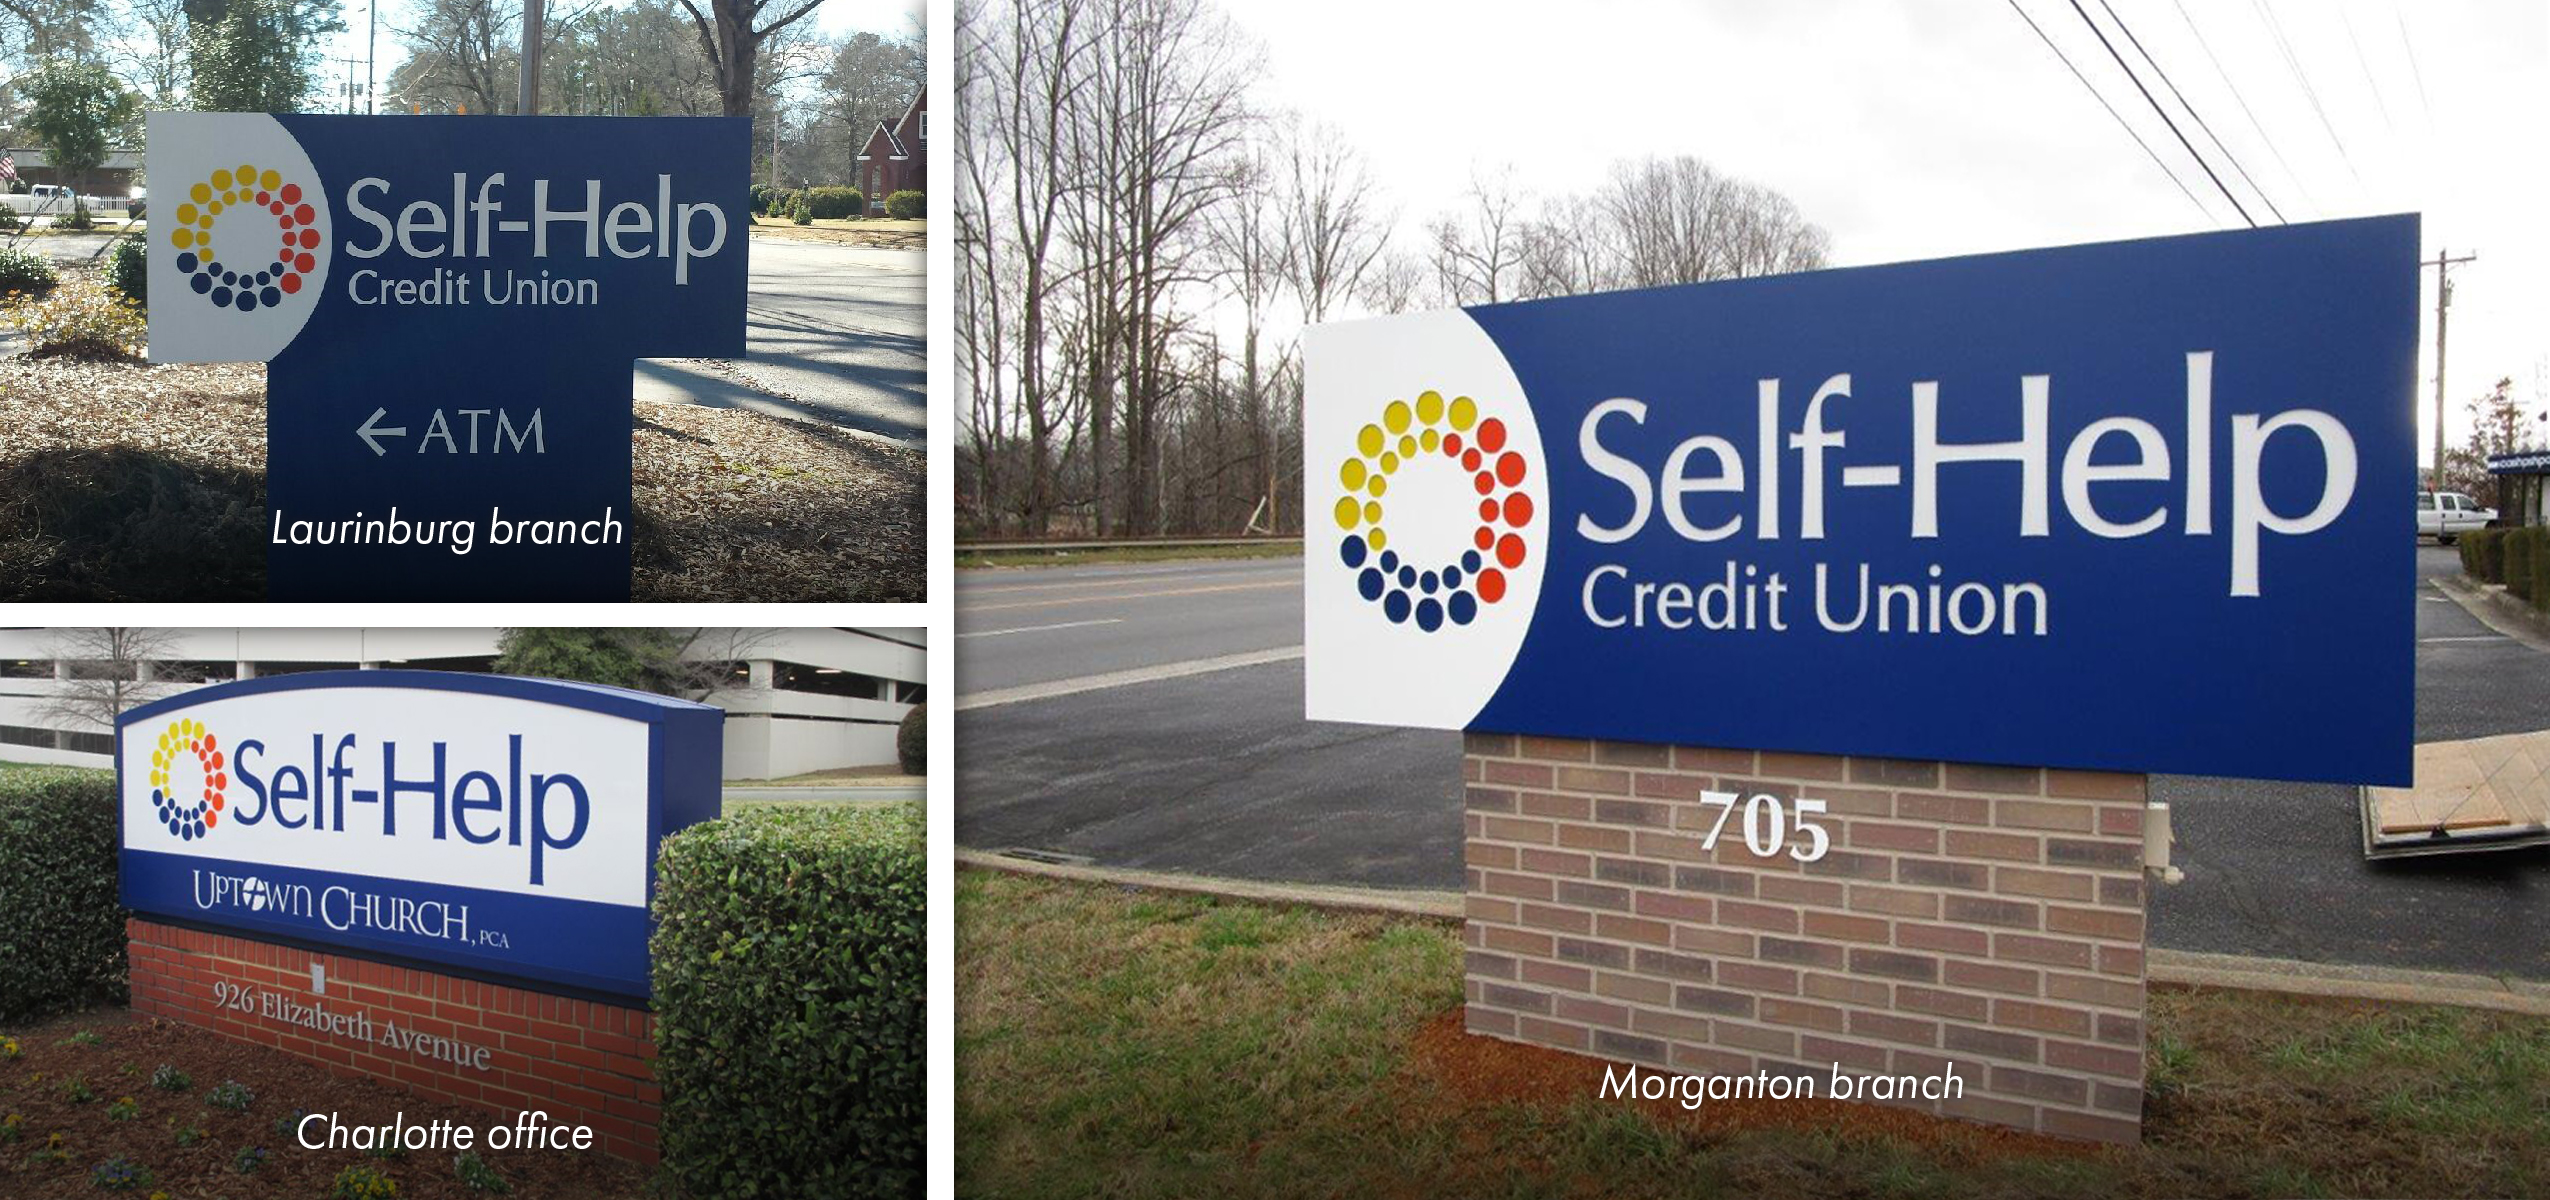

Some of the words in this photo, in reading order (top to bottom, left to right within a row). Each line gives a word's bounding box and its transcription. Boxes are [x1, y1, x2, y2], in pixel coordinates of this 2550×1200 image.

[346, 172, 728, 286] Self-Help
[349, 267, 470, 306] Credit
[484, 269, 599, 306] Union
[418, 408, 545, 456] ATM
[1576, 350, 2358, 598] Self-Help
[1581, 561, 1788, 631] Credit
[1814, 563, 2049, 636] Union
[233, 732, 591, 886] Self-Help
[1699, 789, 1831, 863] 705
[479, 929, 510, 949] PCA
[214, 980, 255, 1014] 926
[261, 991, 374, 1043] Elizabeth
[380, 1019, 492, 1071] Avenue
